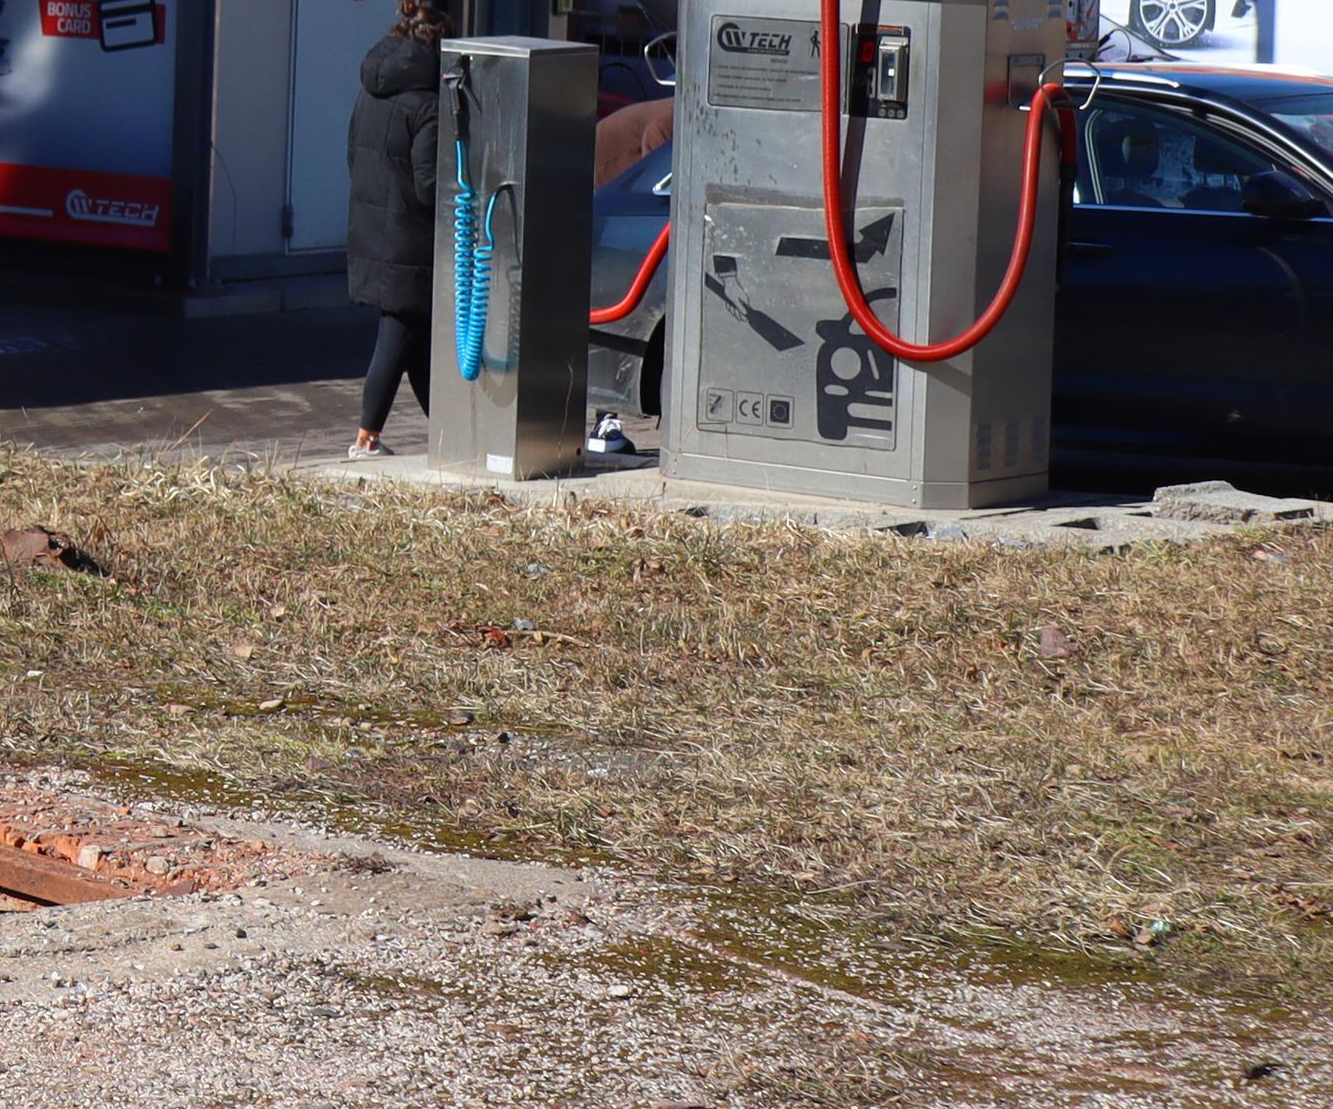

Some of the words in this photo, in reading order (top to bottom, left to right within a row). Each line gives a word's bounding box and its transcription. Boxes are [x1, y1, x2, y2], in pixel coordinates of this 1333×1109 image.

[47, 1, 91, 18] BONUS
[57, 18, 91, 34] CARD
[739, 399, 761, 419] CE
